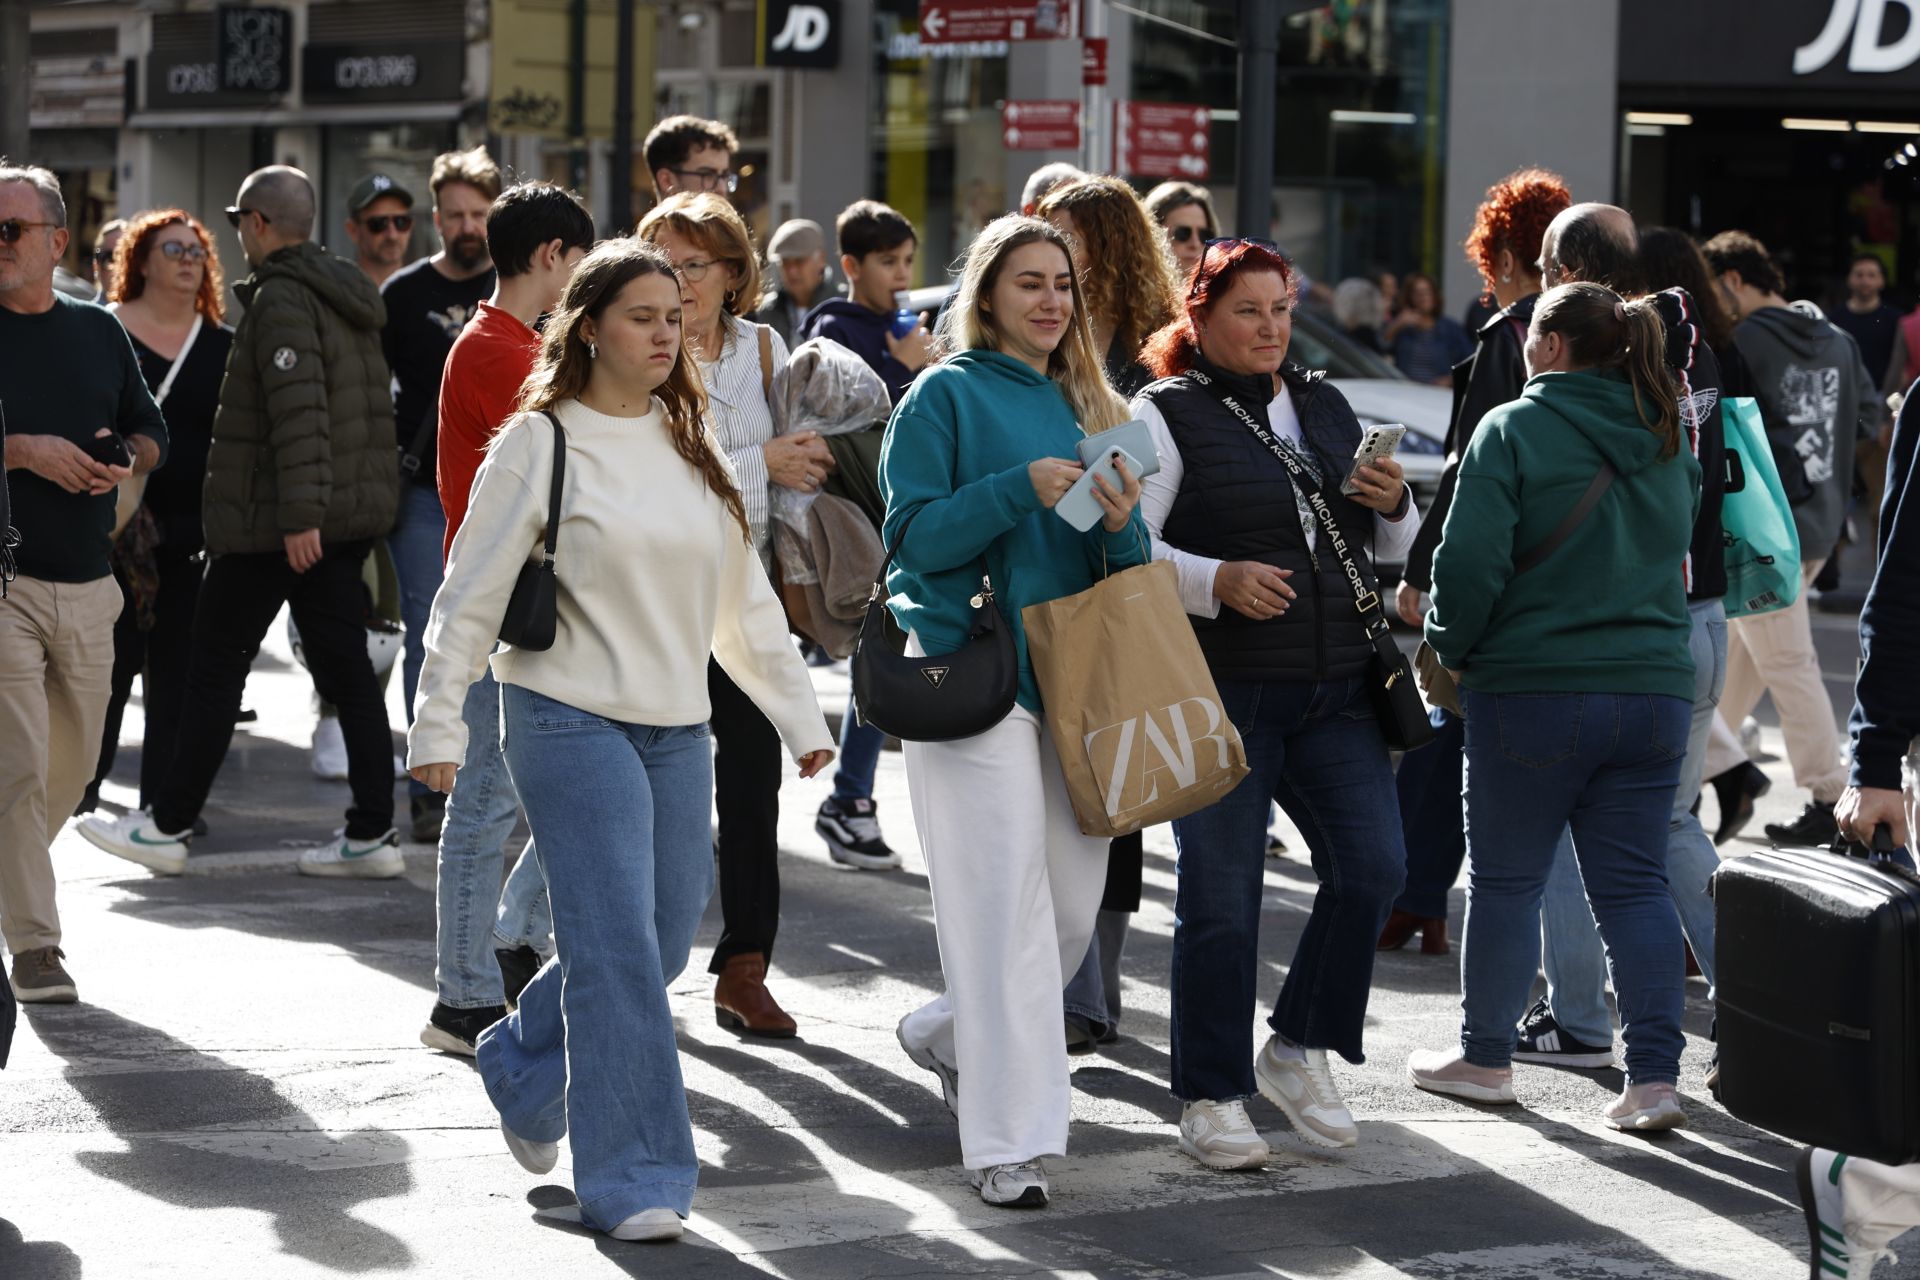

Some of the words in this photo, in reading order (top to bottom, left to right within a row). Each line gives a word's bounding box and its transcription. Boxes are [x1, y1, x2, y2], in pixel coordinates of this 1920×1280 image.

[772, 4, 830, 51] JD
[1792, 0, 1920, 75] JD
[1222, 396, 1271, 444] MICHAEL
[1270, 445, 1302, 475] KORS
[1309, 492, 1348, 557] MICHAEL
[1343, 559, 1367, 598] KORS
